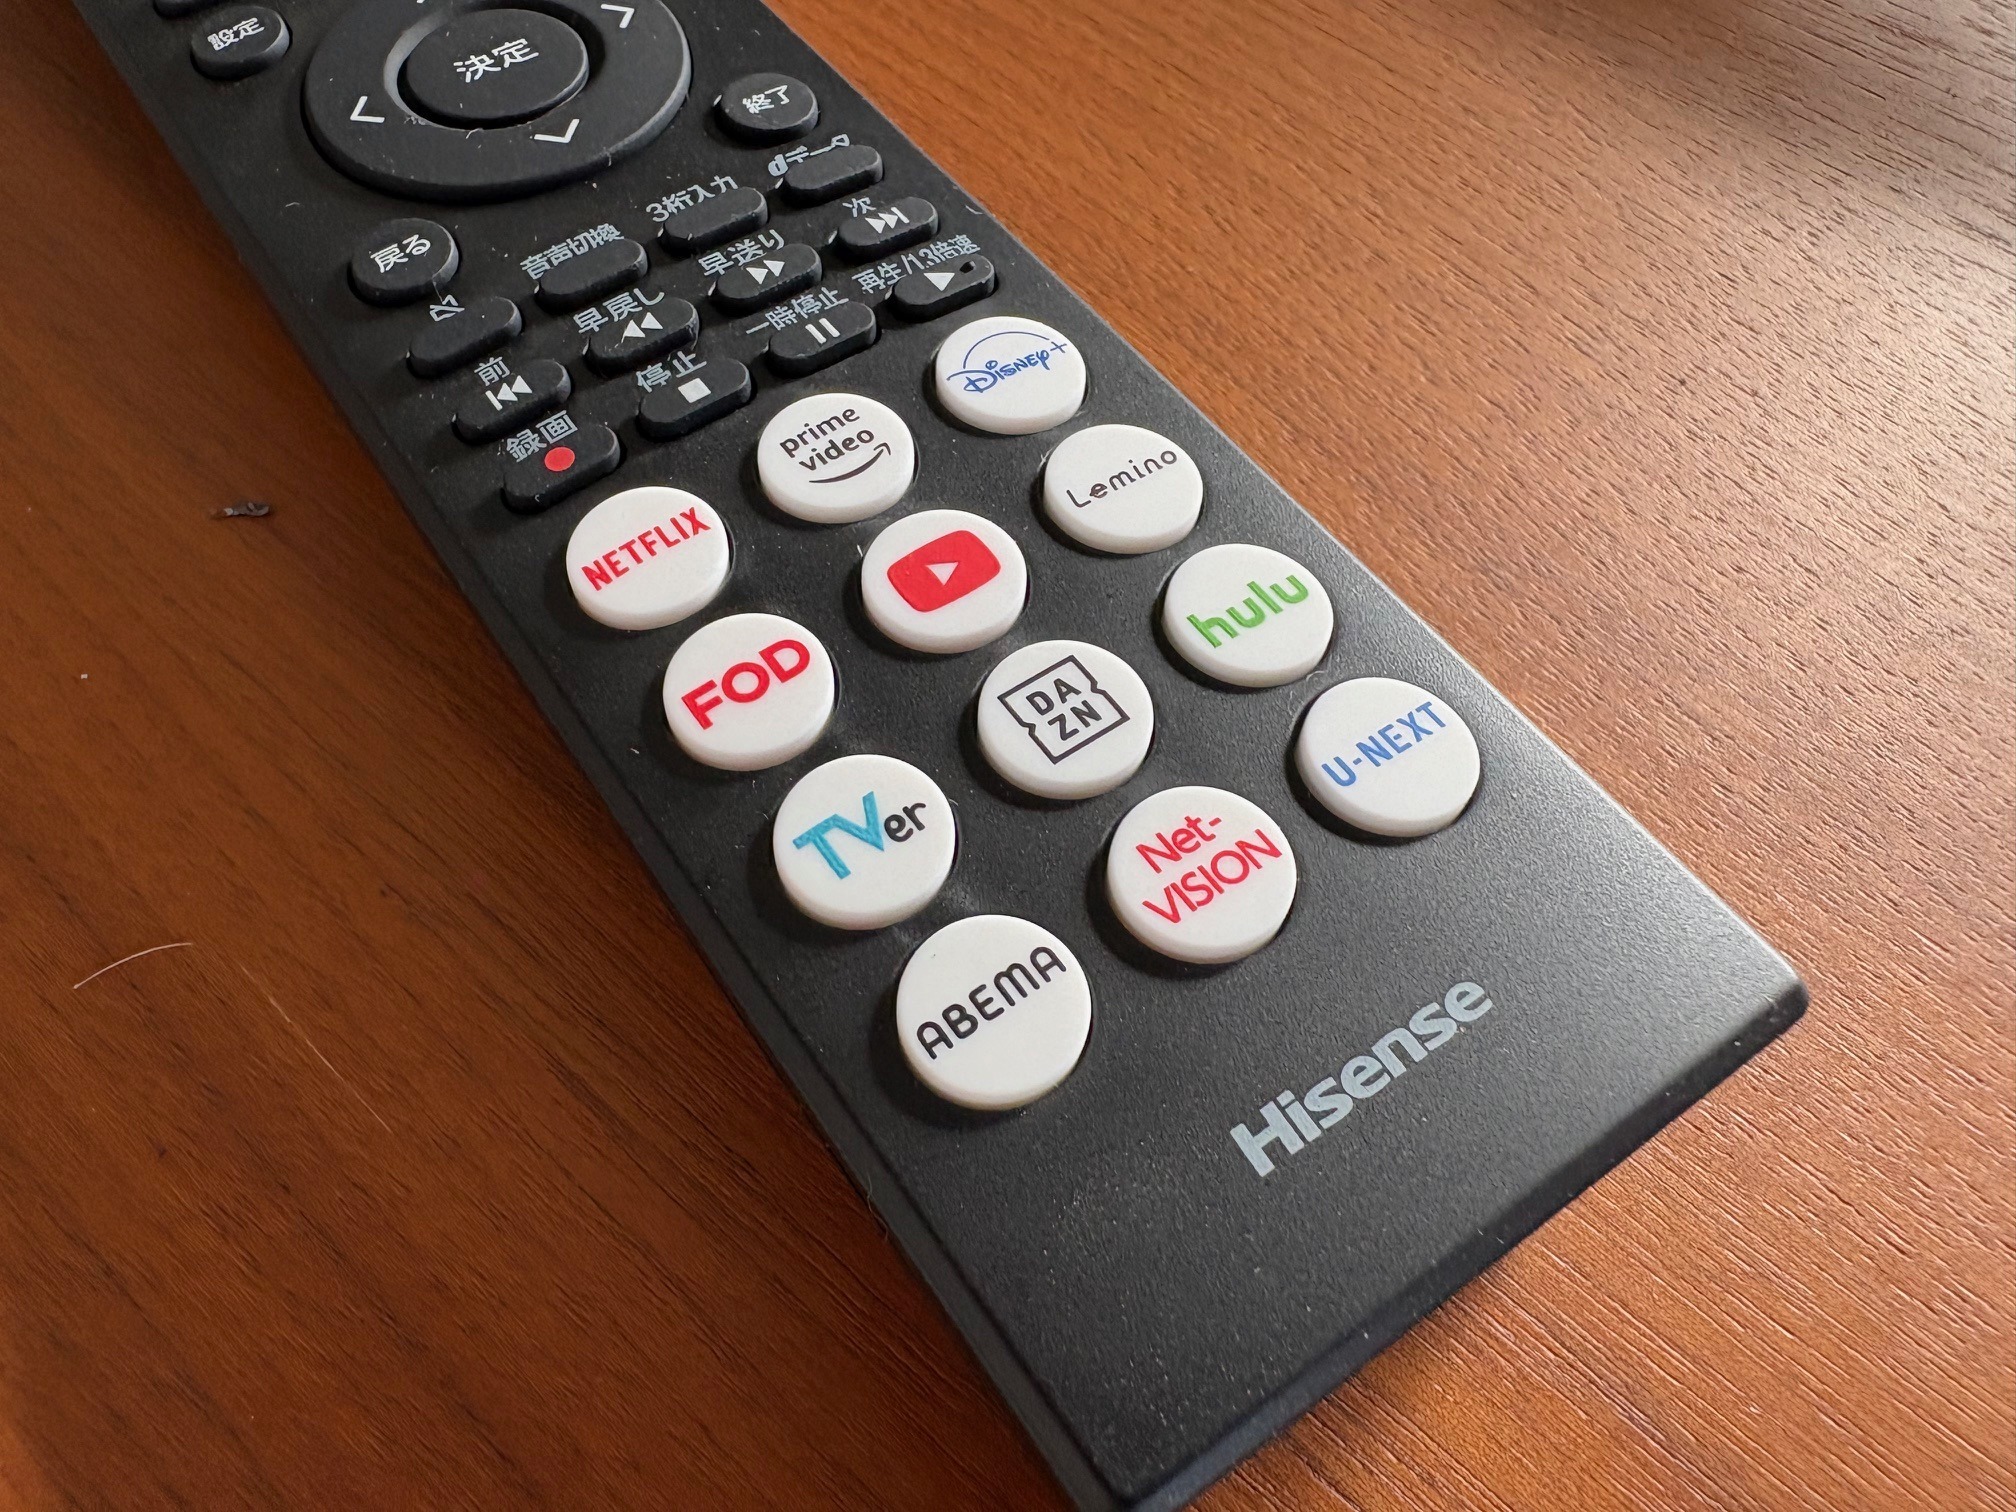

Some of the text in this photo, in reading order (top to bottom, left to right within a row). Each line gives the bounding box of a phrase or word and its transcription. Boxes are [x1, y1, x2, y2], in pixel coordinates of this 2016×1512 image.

[207, 17, 264, 51] 設定
[453, 38, 539, 83] 決定
[742, 84, 790, 114] 終了
[645, 175, 738, 223] 3桁入力
[842, 196, 875, 218] 次
[370, 234, 431, 274] 戻る
[520, 222, 625, 280] 音声切換
[698, 229, 786, 278] 早送り
[851, 234, 981, 295] 再生/1.3倍速
[573, 287, 665, 335] 早戻し
[746, 286, 849, 335] 一時停止
[473, 356, 511, 387] 前
[635, 350, 707, 393] 停止
[505, 410, 578, 463] 録画
[780, 408, 860, 459] prime
[798, 429, 875, 471] video
[1066, 449, 1178, 508] Lemino
[581, 506, 711, 592] NETFLIX
[1186, 574, 1309, 649] hulu
[681, 639, 811, 730] FOD
[1024, 677, 1082, 716] DA
[1046, 699, 1103, 742] ZN
[1320, 701, 1447, 788] U-NEXT
[792, 790, 927, 881] TVer
[1135, 814, 1222, 874] Net-
[1142, 828, 1283, 924] VISION
[916, 946, 1067, 1061] ABEMA
[1229, 981, 1493, 1178] Hisense
